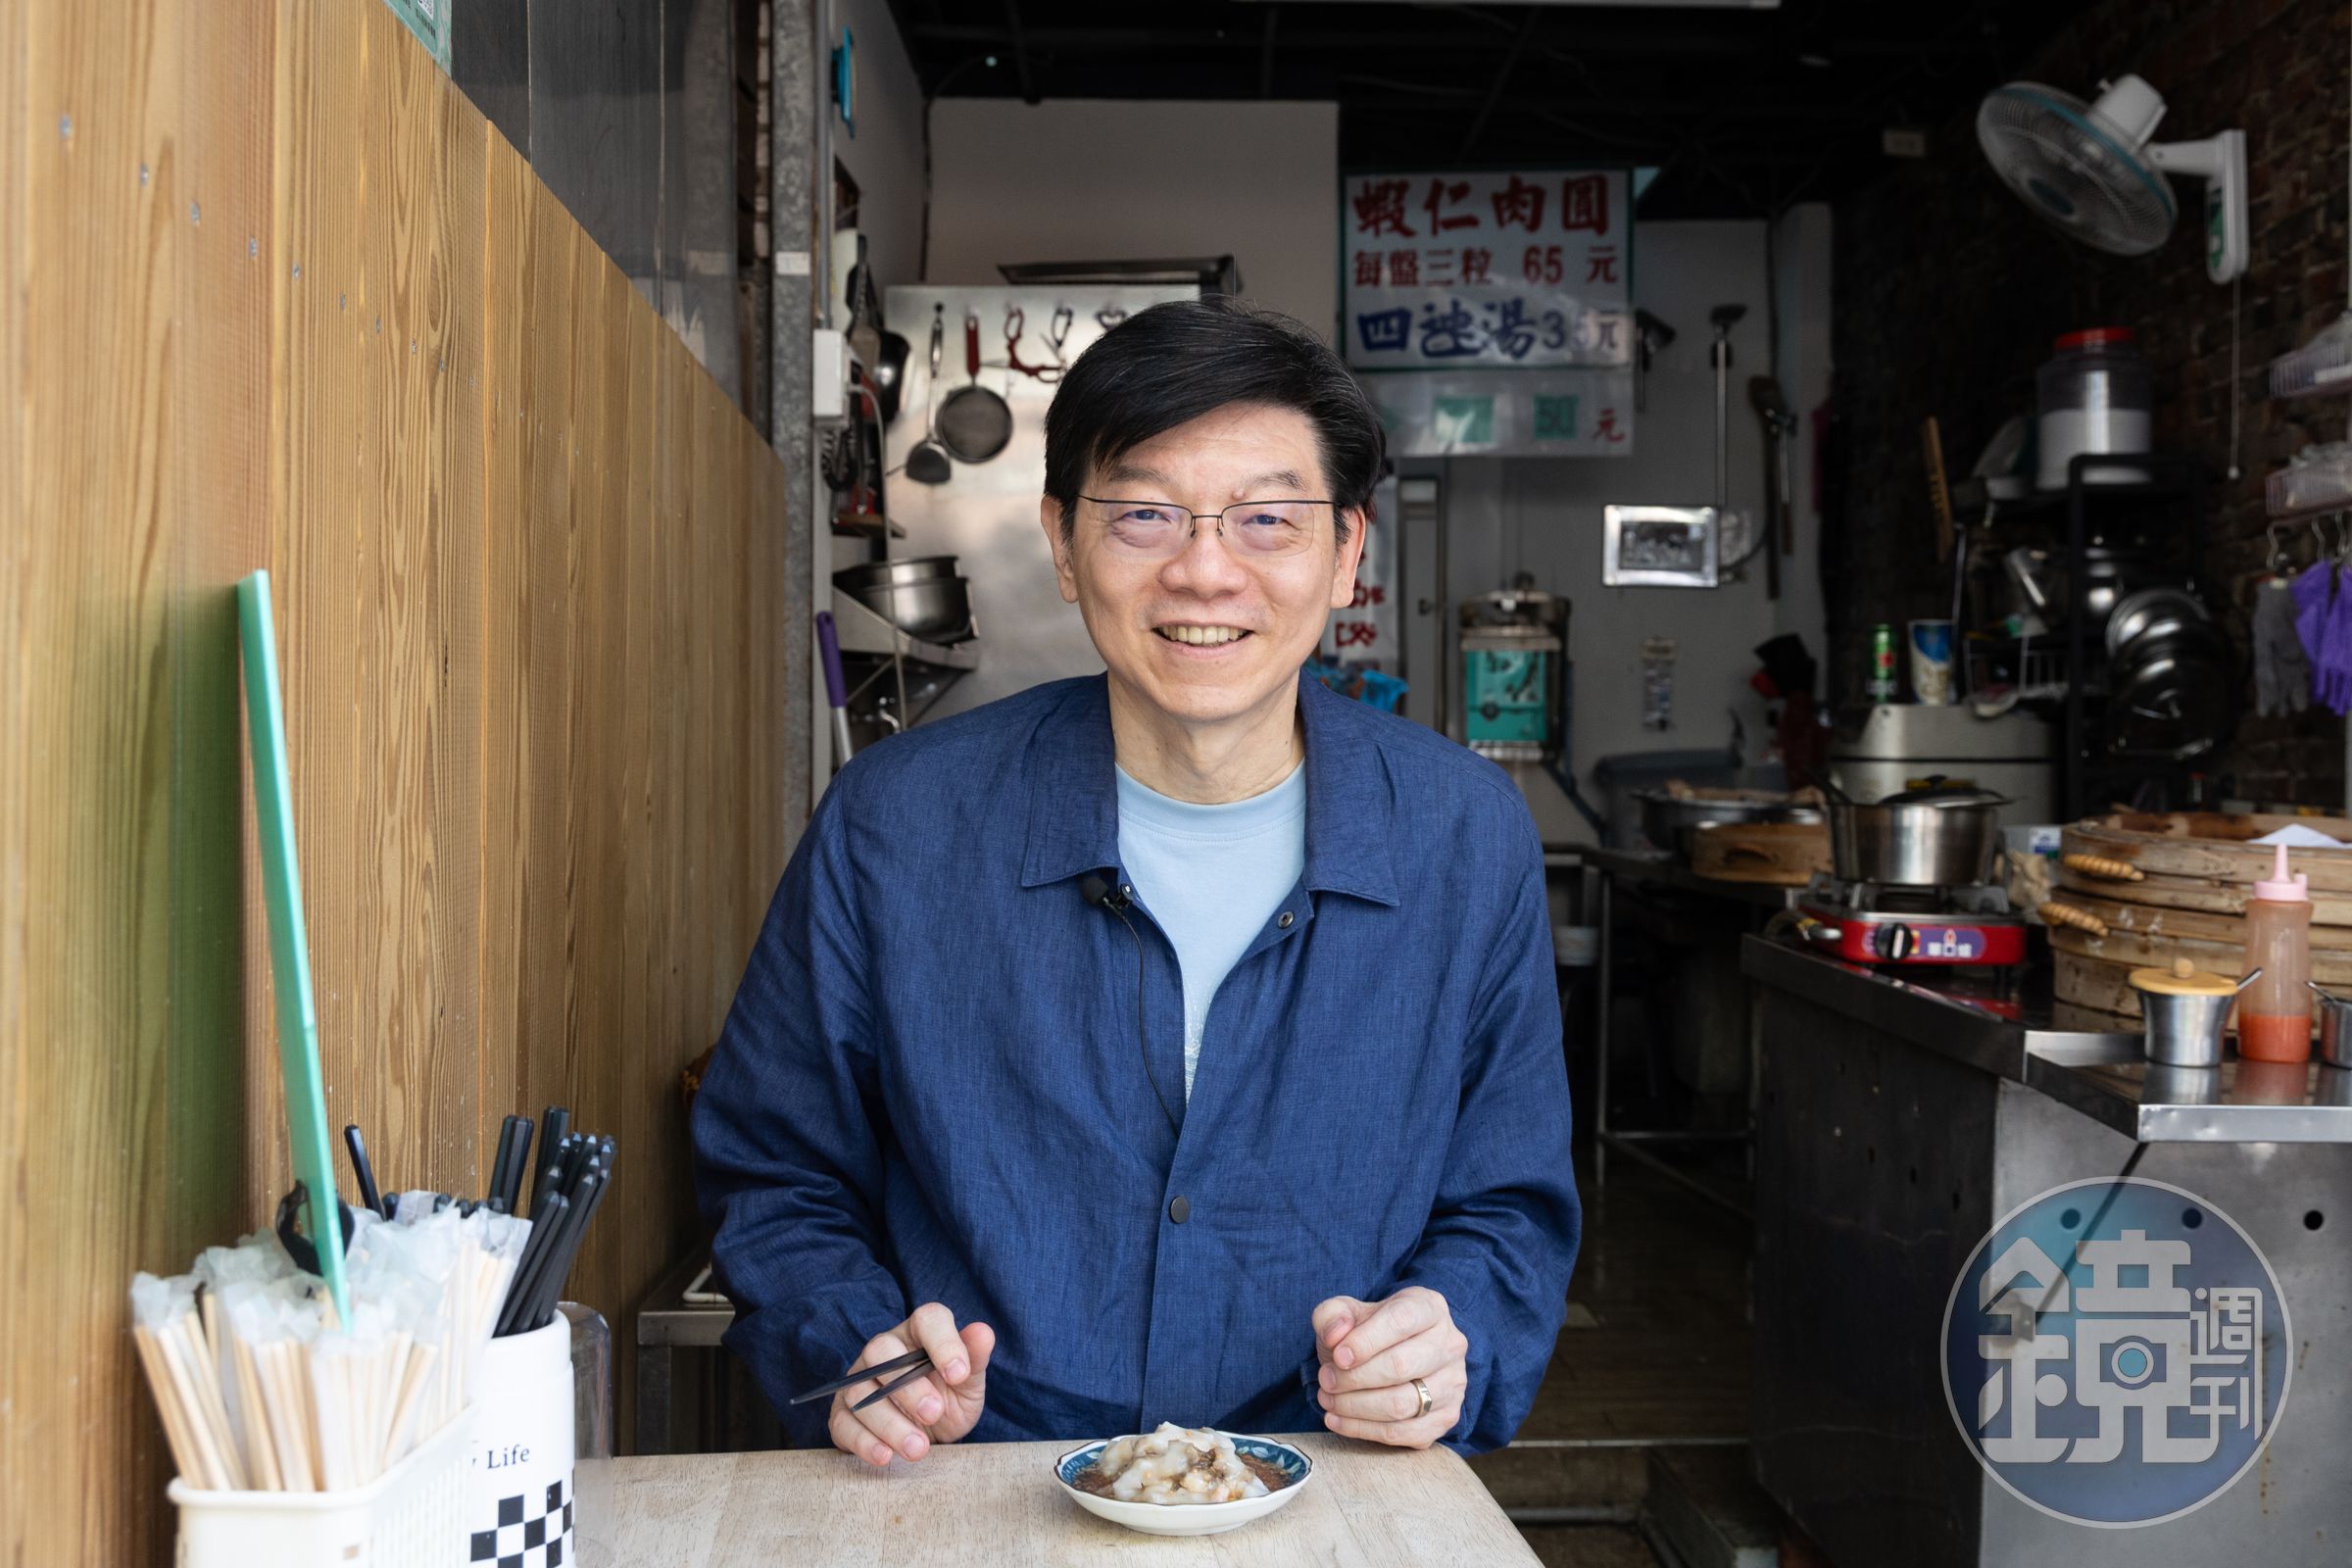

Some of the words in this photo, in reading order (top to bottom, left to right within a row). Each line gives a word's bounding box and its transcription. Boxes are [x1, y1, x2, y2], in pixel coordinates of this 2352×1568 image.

[1353, 173, 1610, 237] 蝦仁肉圓
[1523, 245, 1564, 283] 65
[1587, 245, 1619, 283] 元
[1591, 408, 1625, 443] 元
[487, 1444, 530, 1469] Life
